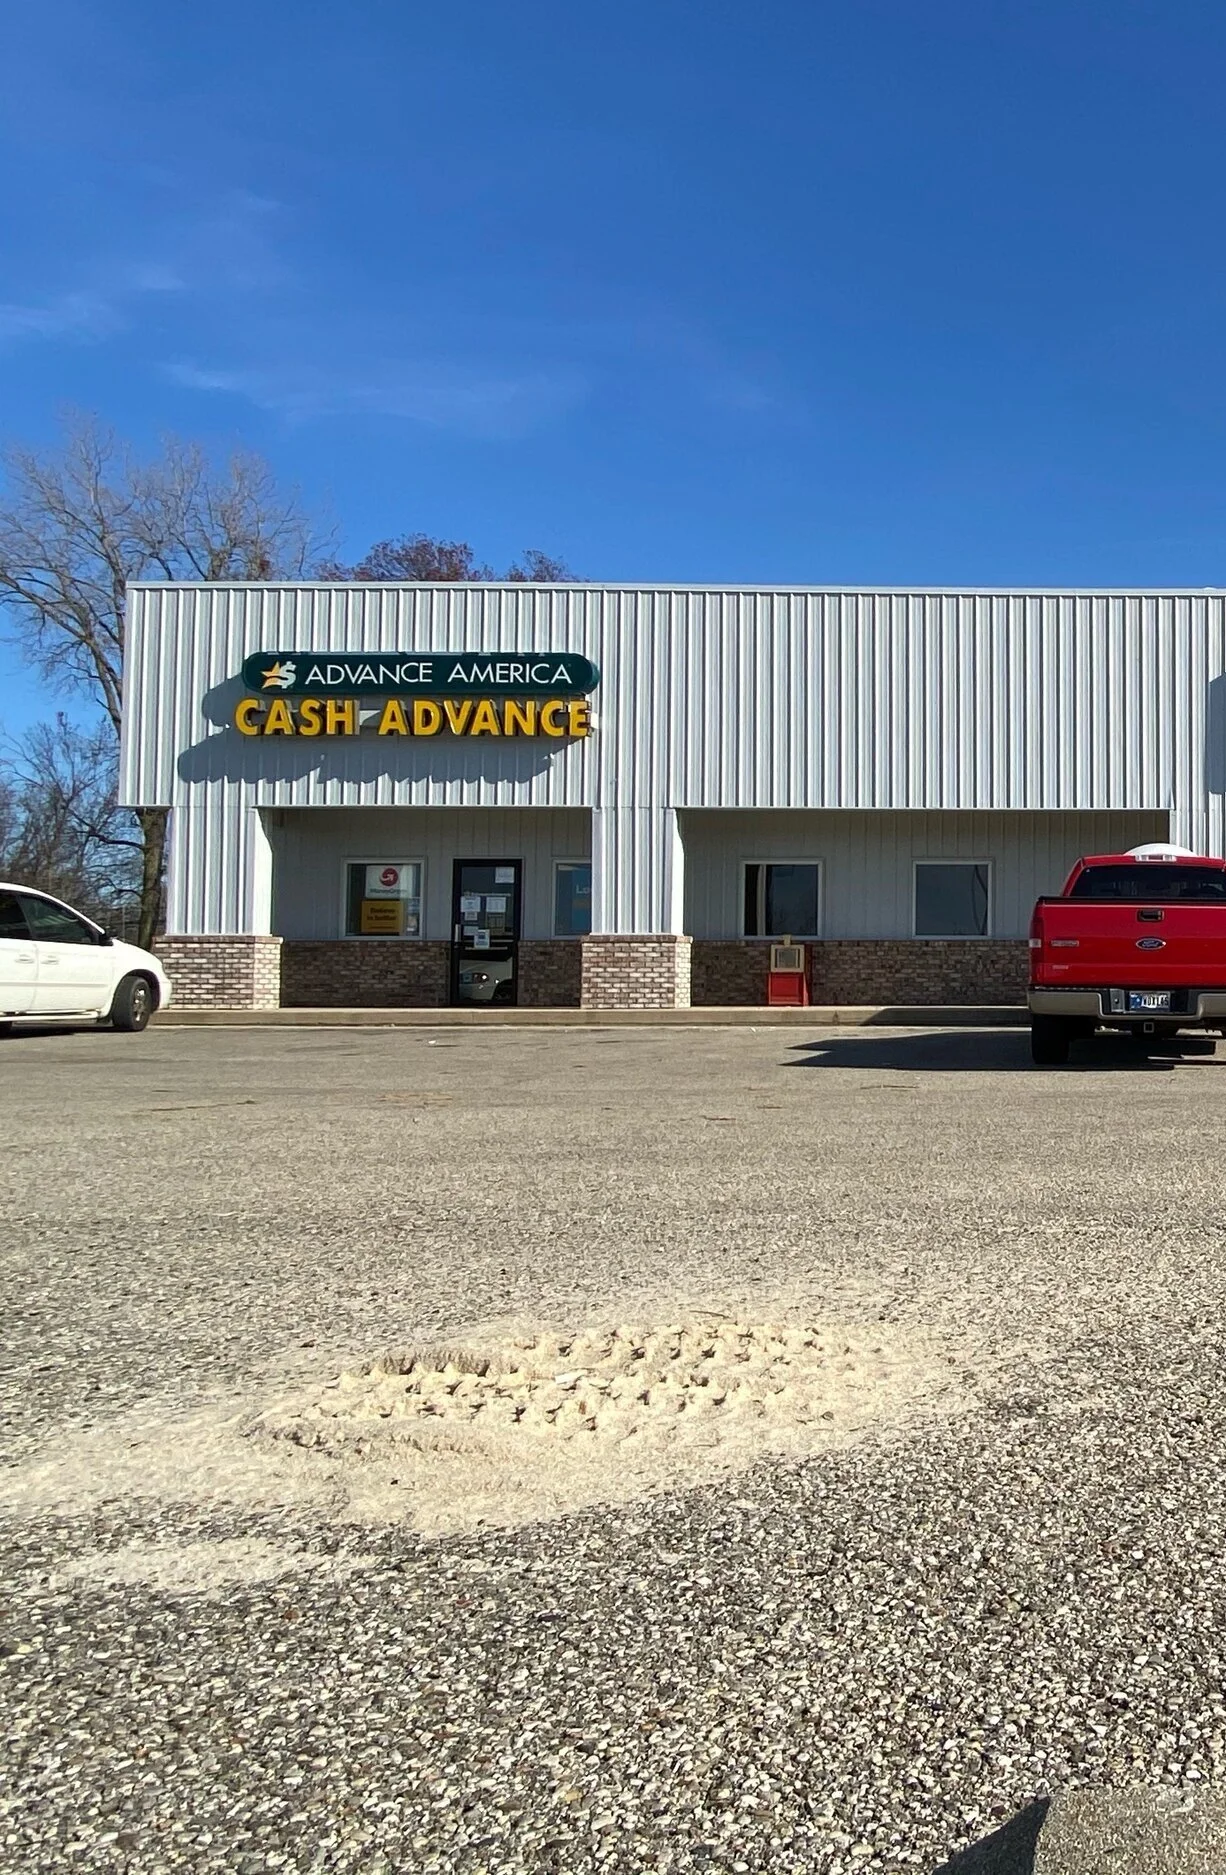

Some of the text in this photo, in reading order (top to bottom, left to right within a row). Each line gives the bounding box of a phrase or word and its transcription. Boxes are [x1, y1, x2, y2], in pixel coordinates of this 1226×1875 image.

[304, 662, 433, 685] ADVANCE
[447, 662, 573, 685] AMERICA
[234, 697, 589, 737] CASH ADVANCE
